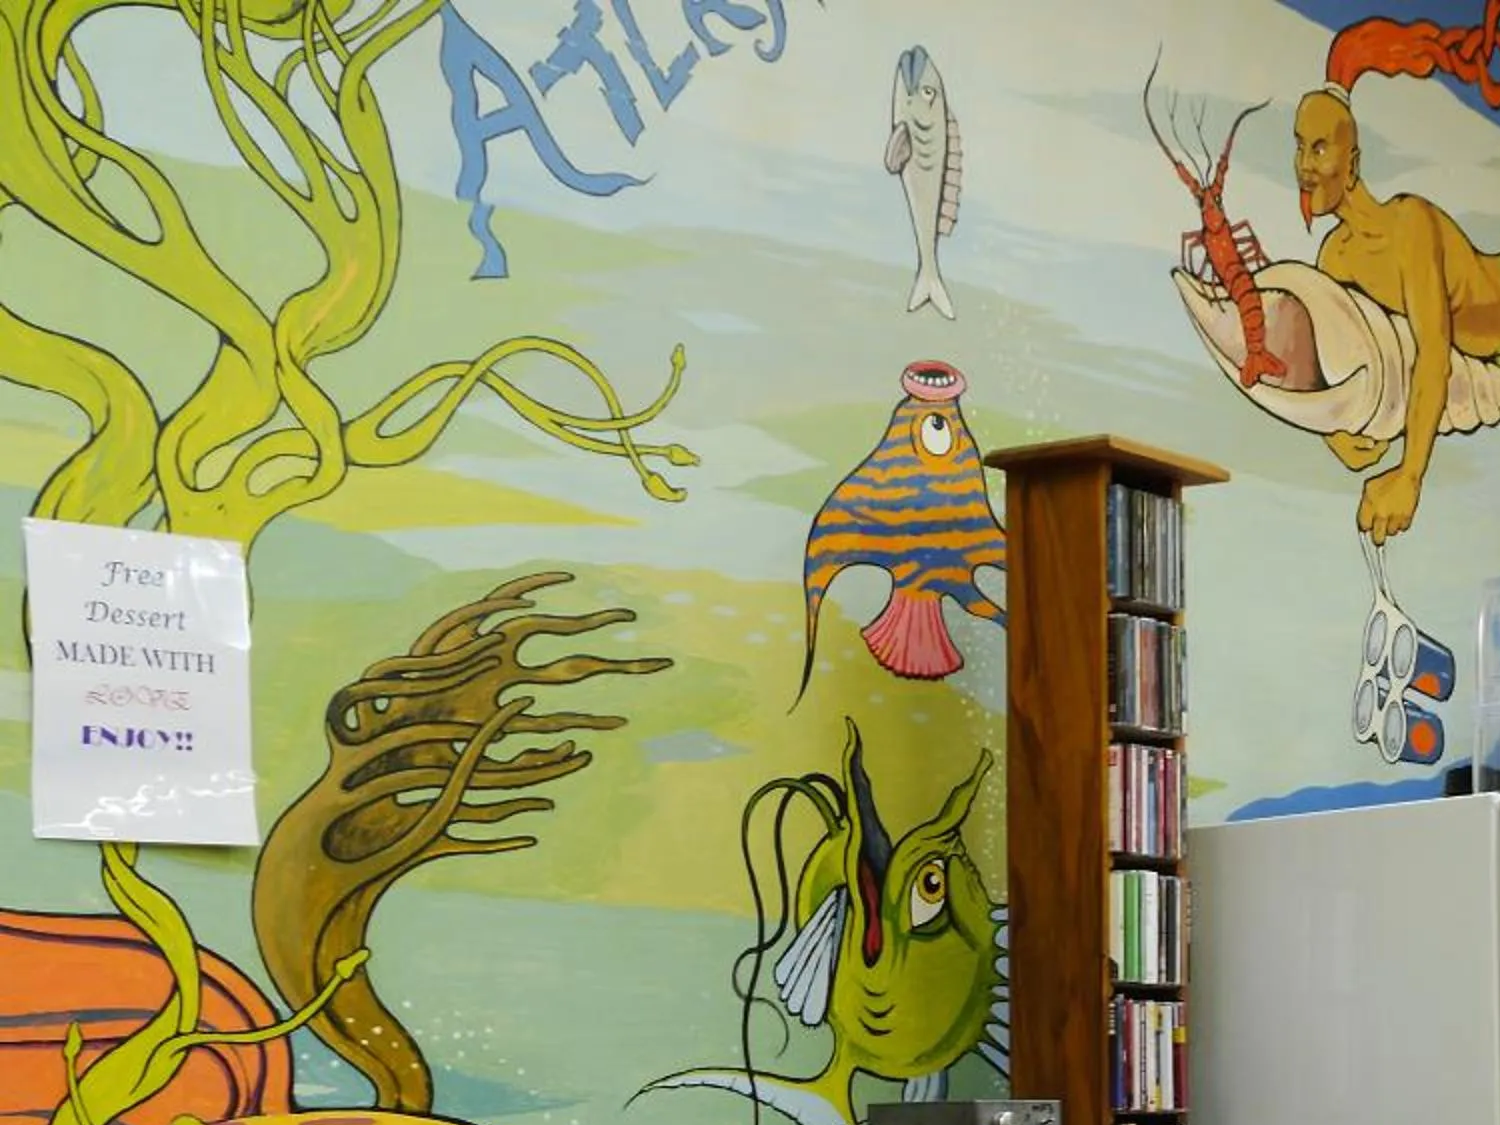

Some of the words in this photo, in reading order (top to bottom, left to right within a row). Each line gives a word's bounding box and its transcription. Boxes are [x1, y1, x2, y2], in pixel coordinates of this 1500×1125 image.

[101, 560, 165, 588] Free
[84, 600, 187, 632] Dessert
[56, 639, 137, 667] MADE
[144, 648, 216, 674] WITH
[81, 725, 194, 751] ENJOY!!
